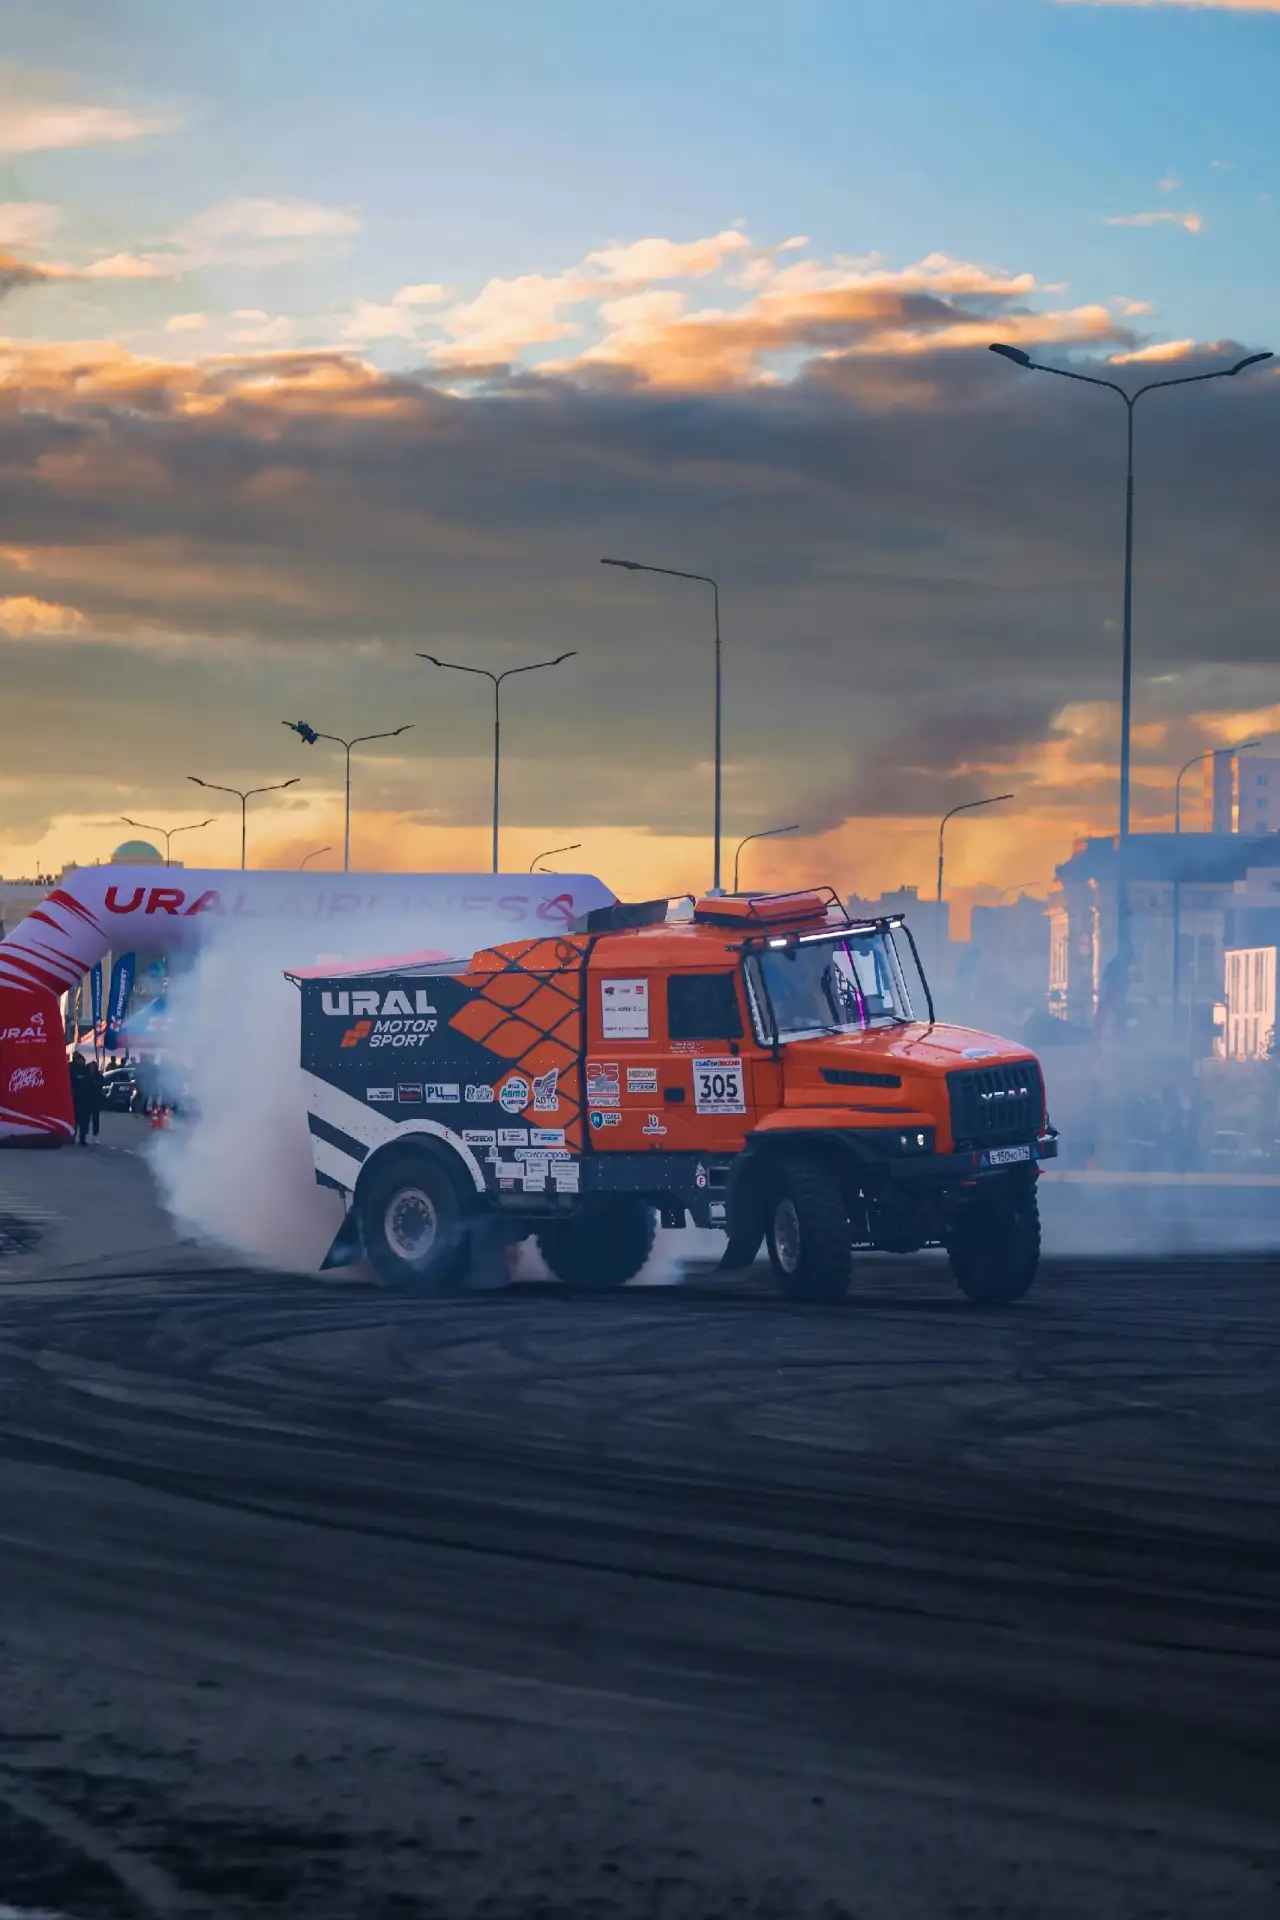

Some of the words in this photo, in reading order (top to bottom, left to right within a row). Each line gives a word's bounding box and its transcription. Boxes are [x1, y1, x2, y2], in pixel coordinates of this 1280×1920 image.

[104, 886, 254, 918] URAL
[321, 990, 437, 1015] URAL
[373, 1020, 438, 1033] MOTOR
[369, 1034, 430, 1048] SPORT
[699, 1074, 738, 1098] 305
